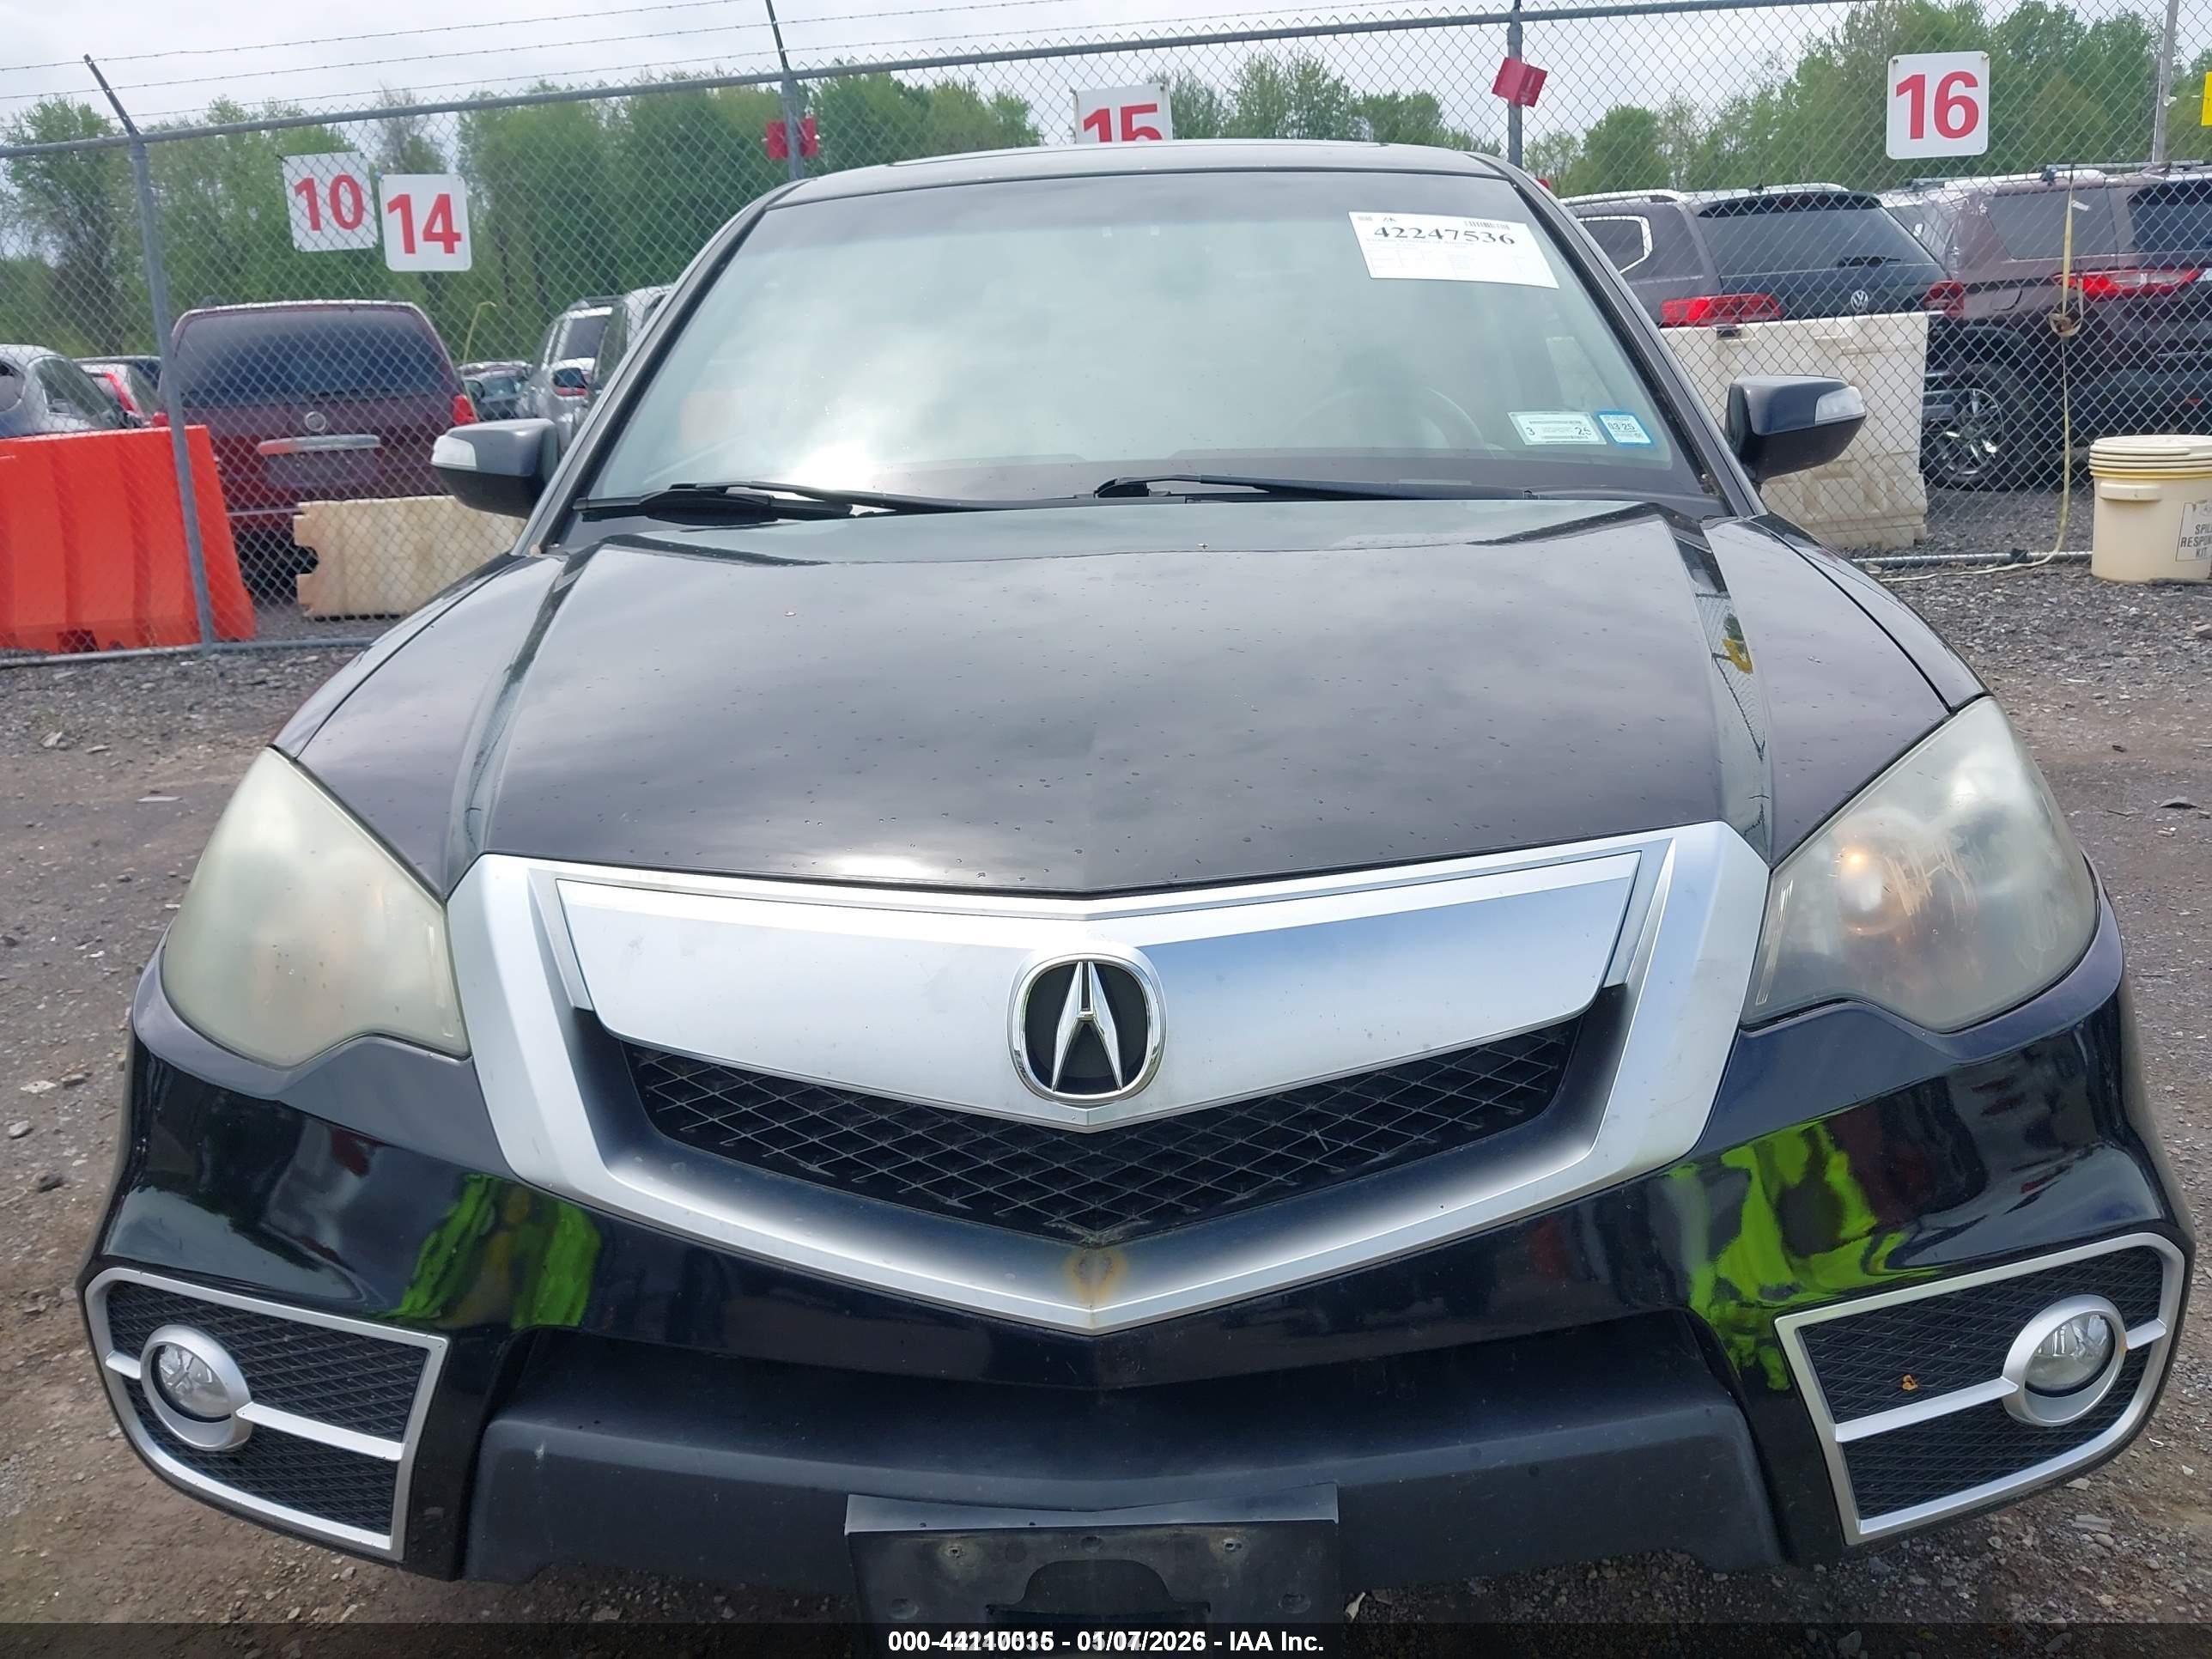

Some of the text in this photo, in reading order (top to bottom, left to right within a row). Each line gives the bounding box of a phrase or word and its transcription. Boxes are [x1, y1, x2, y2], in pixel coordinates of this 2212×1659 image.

[1895, 71, 1979, 139] 16
[294, 173, 364, 231] 10
[386, 193, 462, 254] 14
[1373, 226, 1516, 245] 42247536
[2196, 547, 2208, 558] KIT
